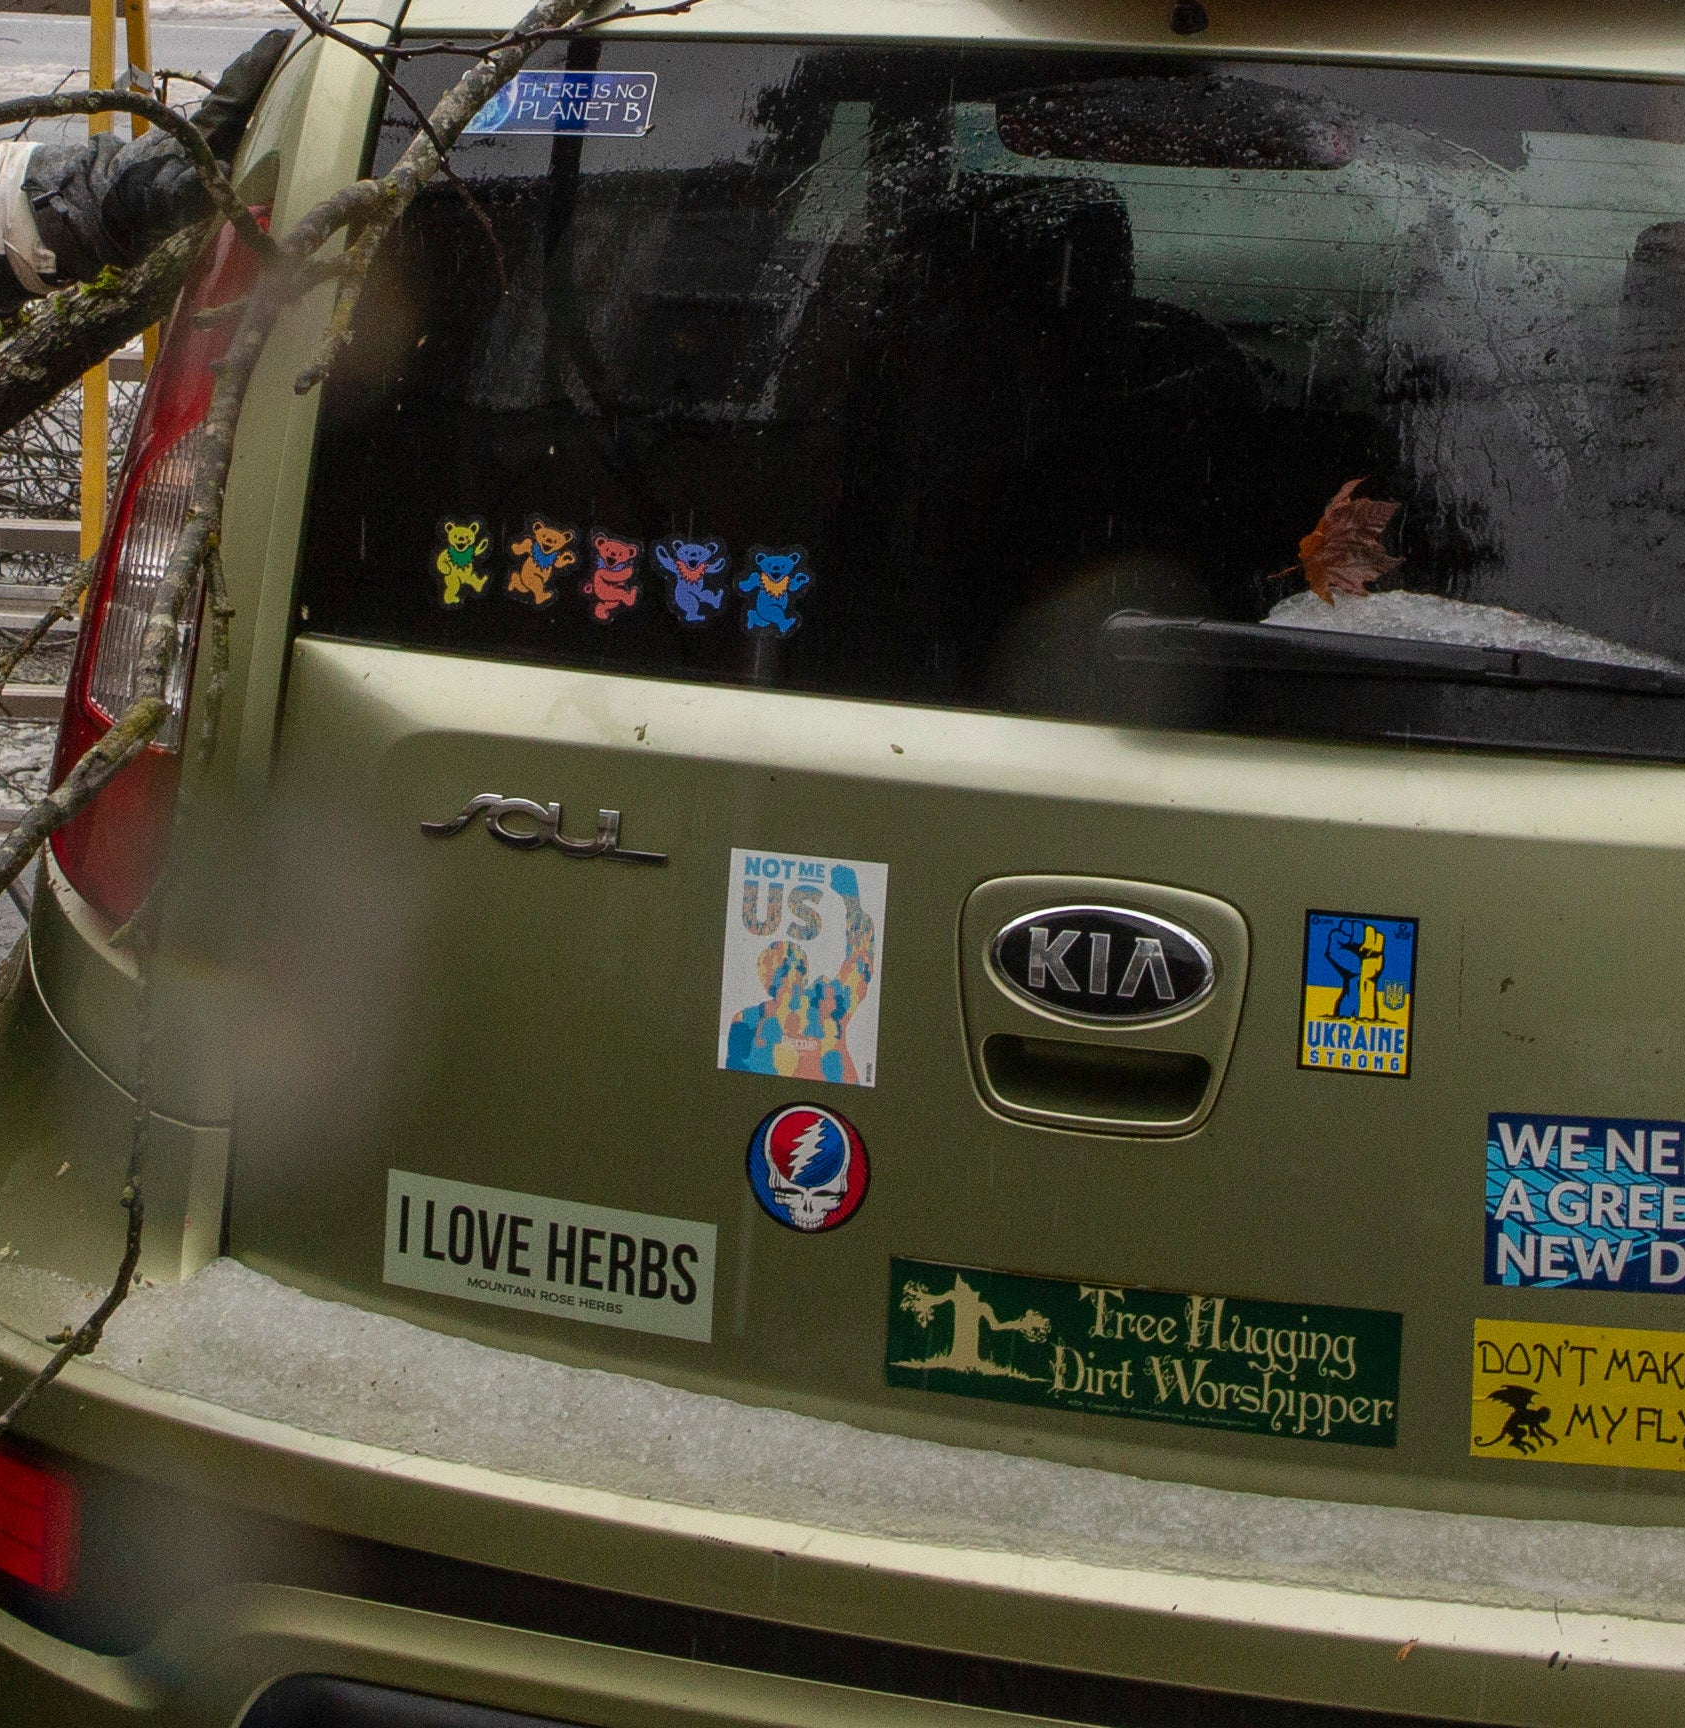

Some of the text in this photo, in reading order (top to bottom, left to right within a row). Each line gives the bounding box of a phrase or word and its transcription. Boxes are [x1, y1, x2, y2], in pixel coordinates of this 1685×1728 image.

[517, 100, 642, 122] PLANET B
[520, 82, 647, 100] THERE IS NO
[744, 856, 826, 879] NOT ME
[742, 880, 824, 941] US
[1028, 927, 1175, 1000] KIA
[1307, 1020, 1406, 1054] UKRAINE
[1309, 1050, 1401, 1071] STRONG
[1497, 1122, 1591, 1171] WE
[1494, 1178, 1536, 1221] A
[398, 1194, 699, 1305] I LOVE HERBS
[1496, 1232, 1632, 1281] NEW
[467, 1276, 624, 1315] MOUNTAIN ROSE HERBS
[1079, 1285, 1358, 1380] Tree Hugging
[1478, 1340, 1598, 1386] DON'T
[1049, 1338, 1394, 1437] Dirt Worshipper
[1564, 1403, 1628, 1445] MY
